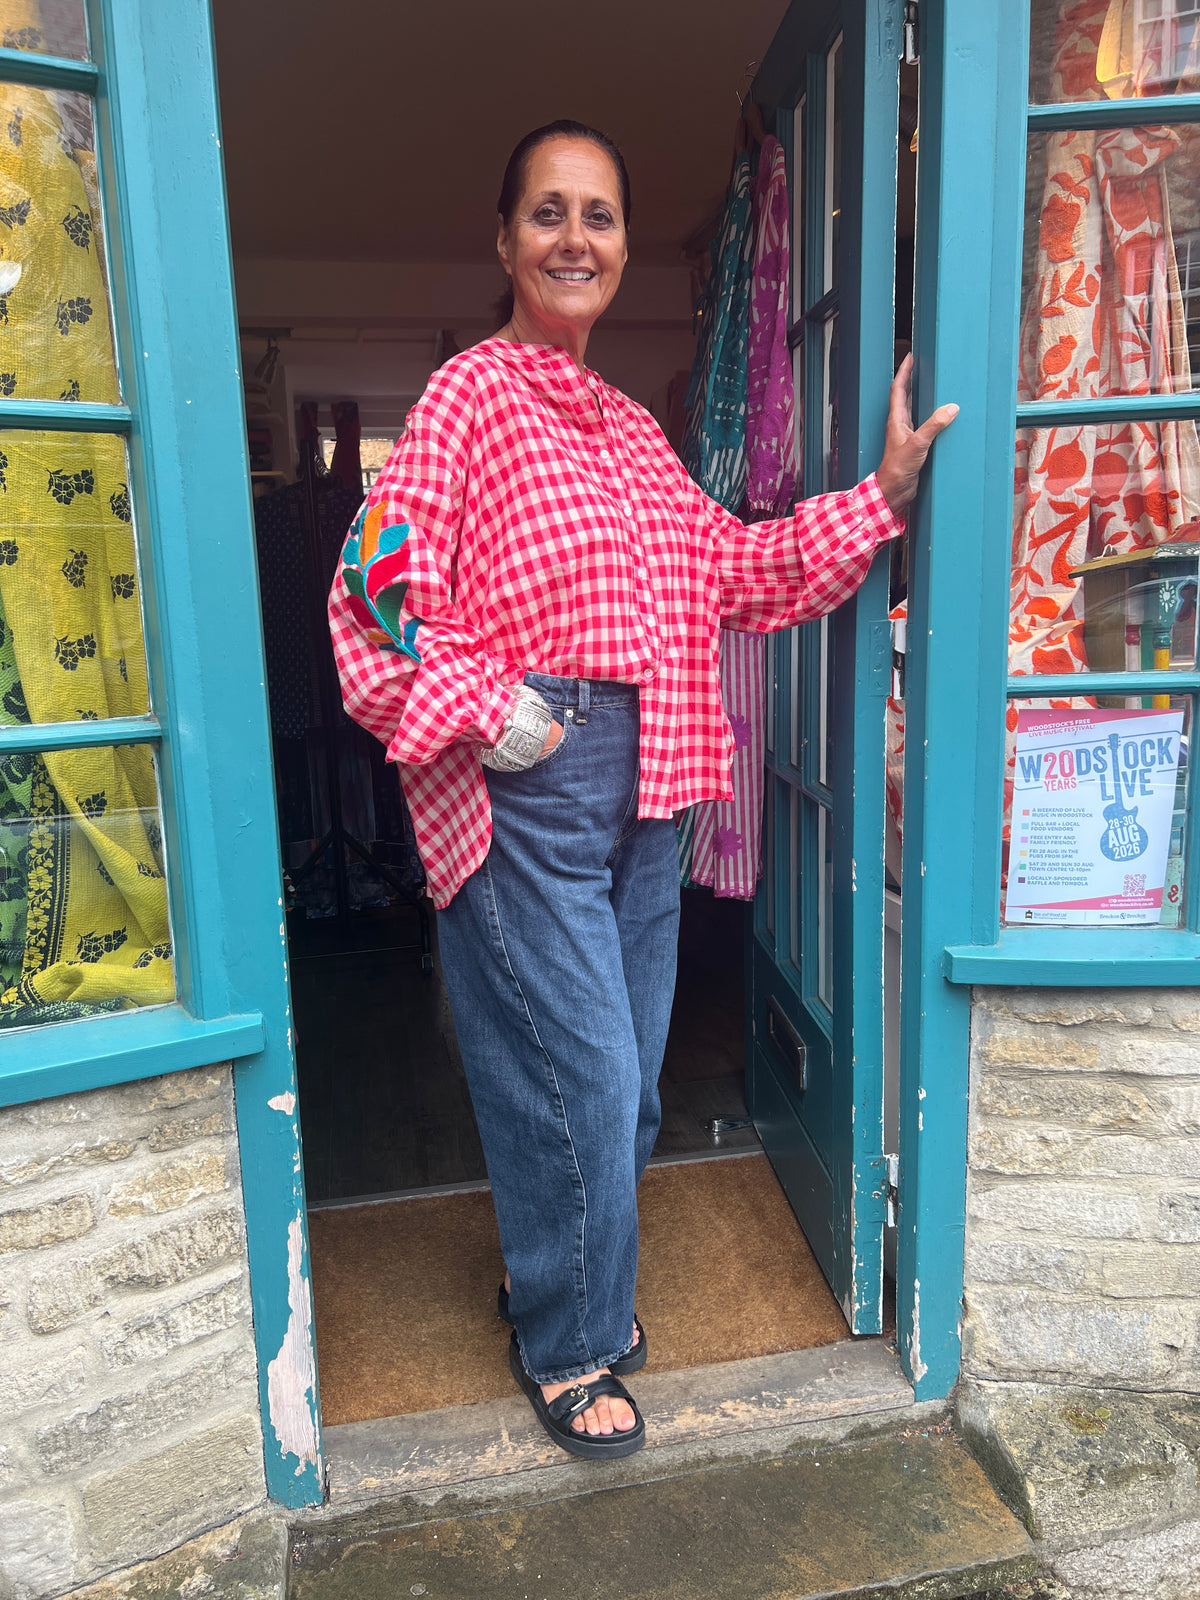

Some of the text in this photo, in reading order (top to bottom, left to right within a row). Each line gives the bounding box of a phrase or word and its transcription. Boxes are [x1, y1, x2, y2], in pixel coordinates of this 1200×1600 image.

[1027, 721, 1074, 731] WOODSTOCK'S
[1028, 724, 1096, 738] LIVE MUSIC FESTIVAL!
[1044, 777, 1078, 792] YEARS
[1109, 814, 1134, 829] 28-30
[1108, 824, 1141, 849] AUG
[1112, 841, 1141, 860] 2026
